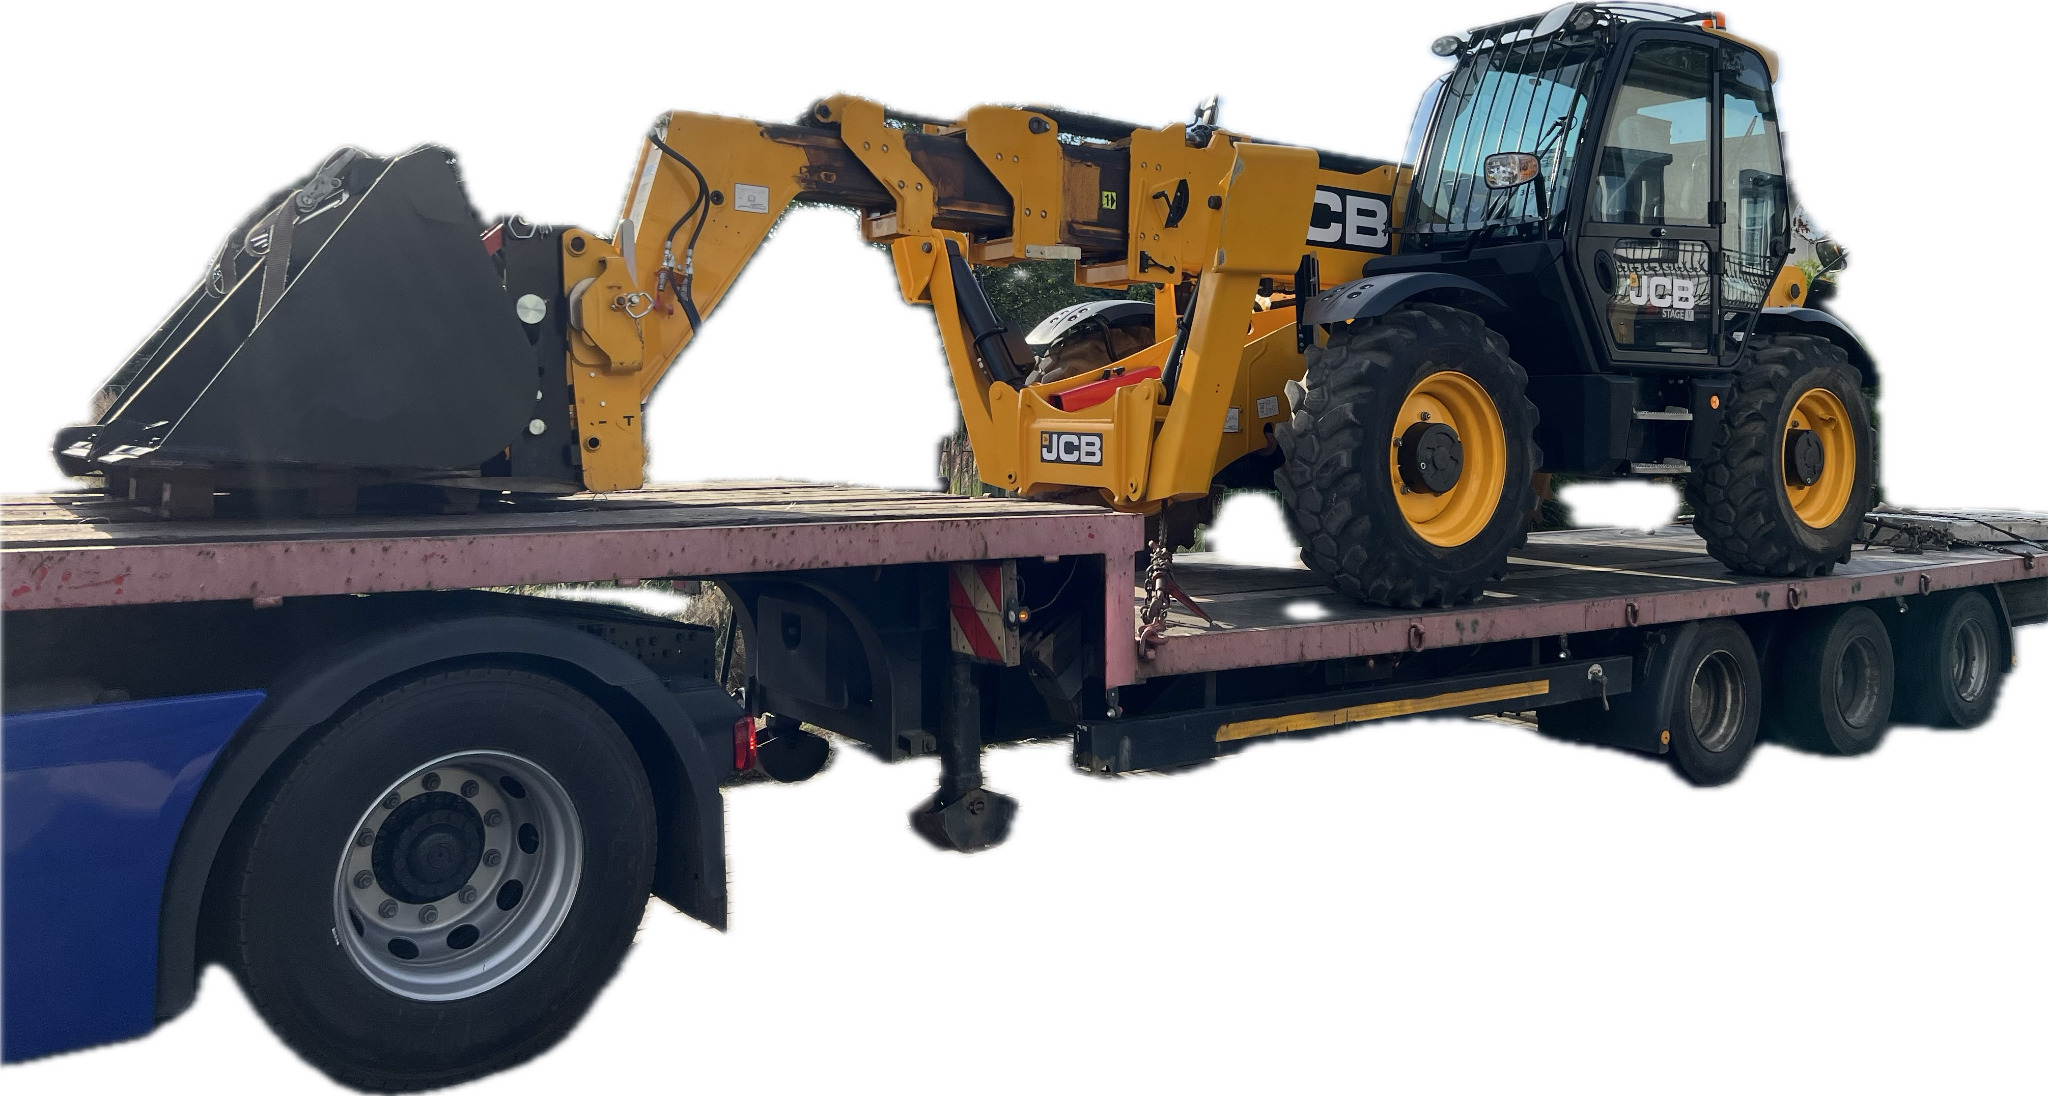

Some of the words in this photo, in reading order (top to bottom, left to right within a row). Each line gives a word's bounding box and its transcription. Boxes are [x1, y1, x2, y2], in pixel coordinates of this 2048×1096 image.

[1307, 190, 1389, 248] CB
[1630, 275, 1695, 309] JCB
[1662, 309, 1685, 319] STAGE
[1042, 433, 1101, 463] JCB
